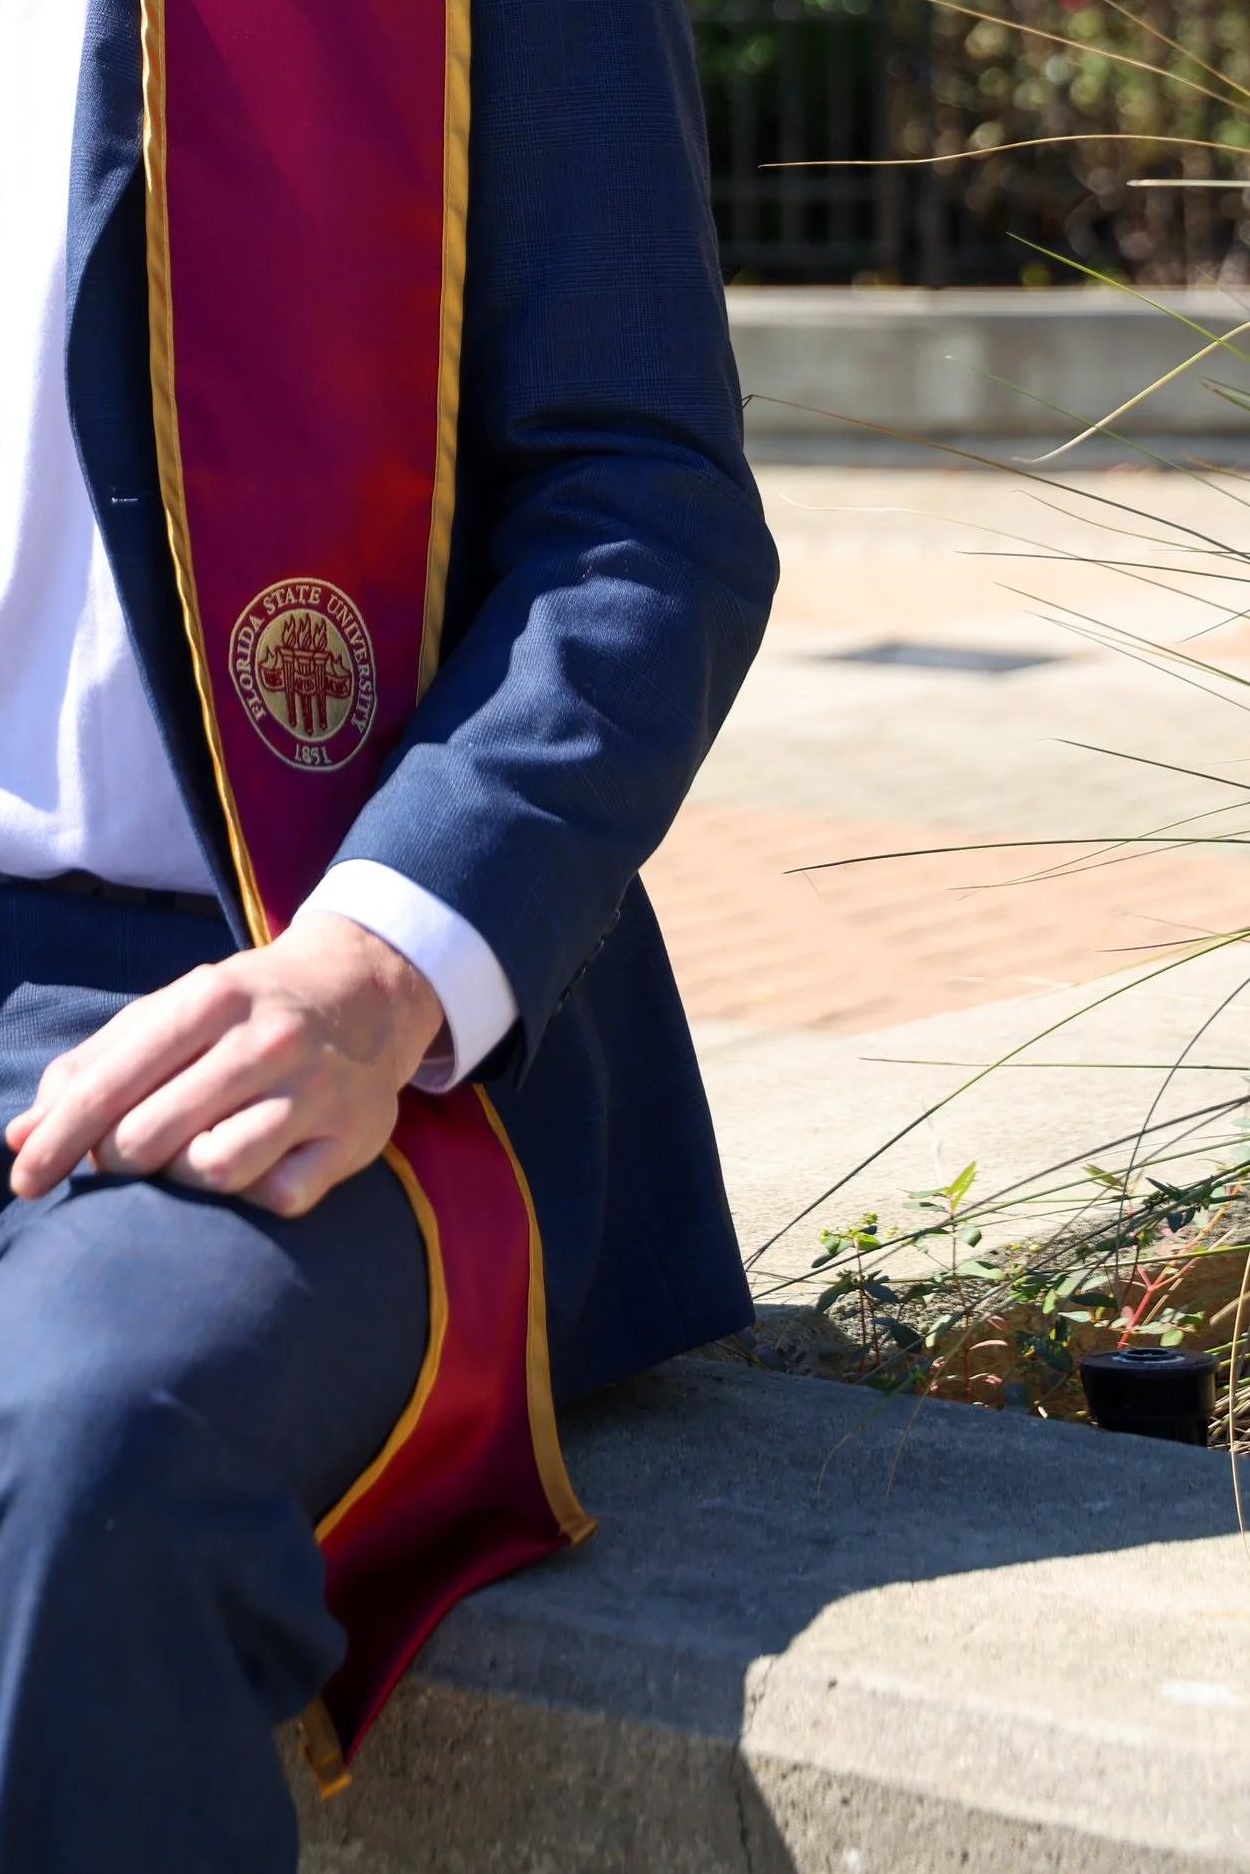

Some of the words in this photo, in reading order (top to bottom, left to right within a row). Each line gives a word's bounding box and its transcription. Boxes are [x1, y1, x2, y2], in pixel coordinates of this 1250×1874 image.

[236, 613, 267, 722] FLORIDA
[263, 584, 322, 616] STATE
[326, 594, 374, 734] UNIVERSITY
[293, 742, 332, 766] 1851
